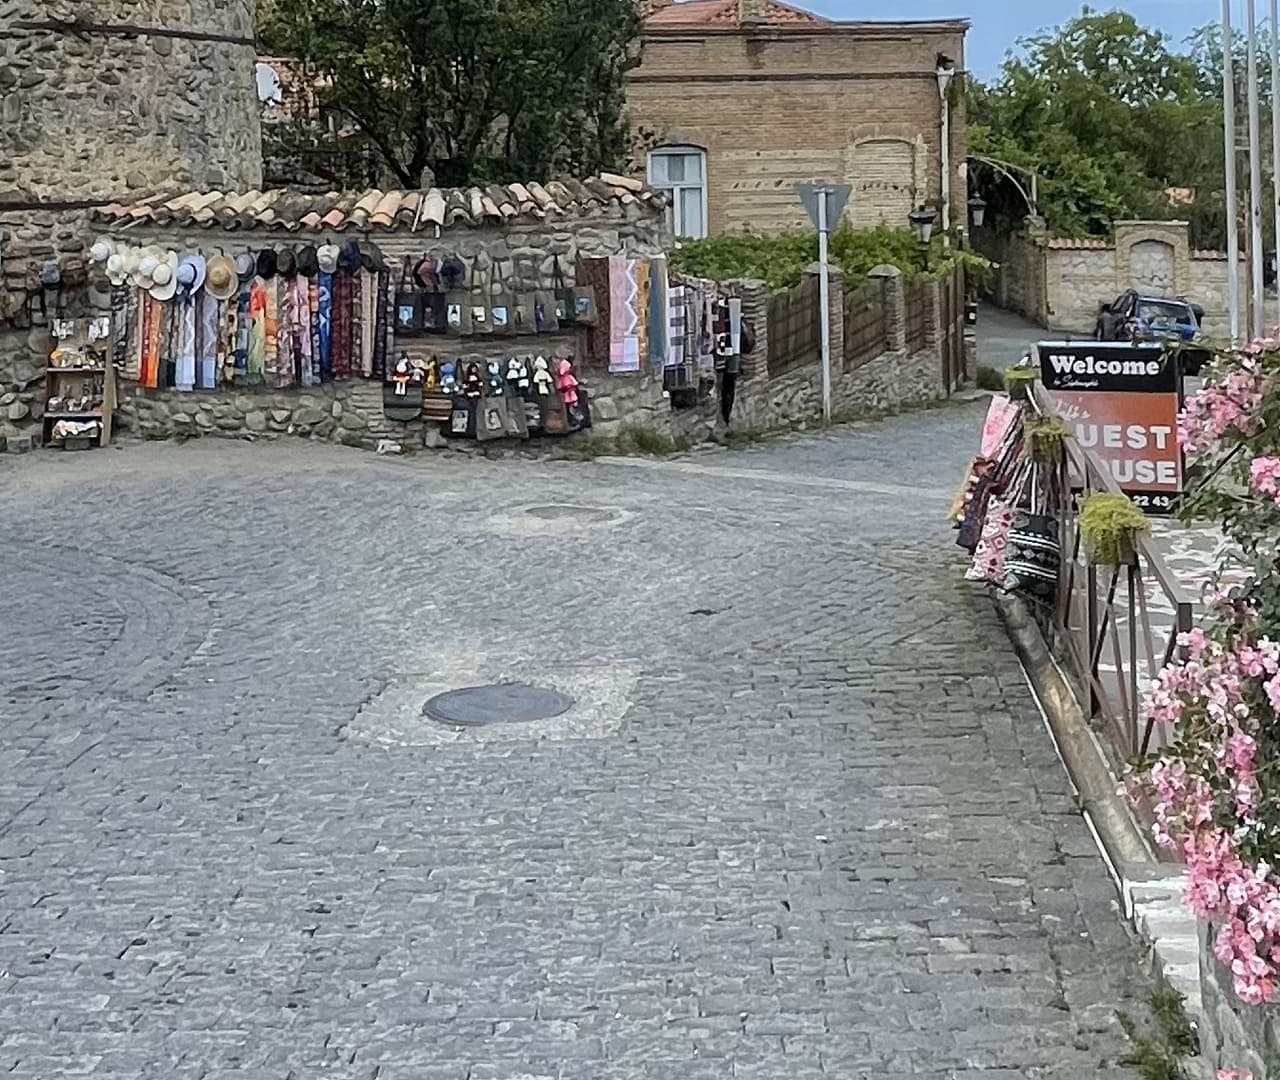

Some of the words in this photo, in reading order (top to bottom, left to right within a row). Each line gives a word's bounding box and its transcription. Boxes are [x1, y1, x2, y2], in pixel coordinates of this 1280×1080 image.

[1049, 355, 1160, 375] Welcome
[1075, 424, 1171, 449] UEST
[1099, 460, 1177, 484] USE
[1152, 496, 1169, 507] 43
